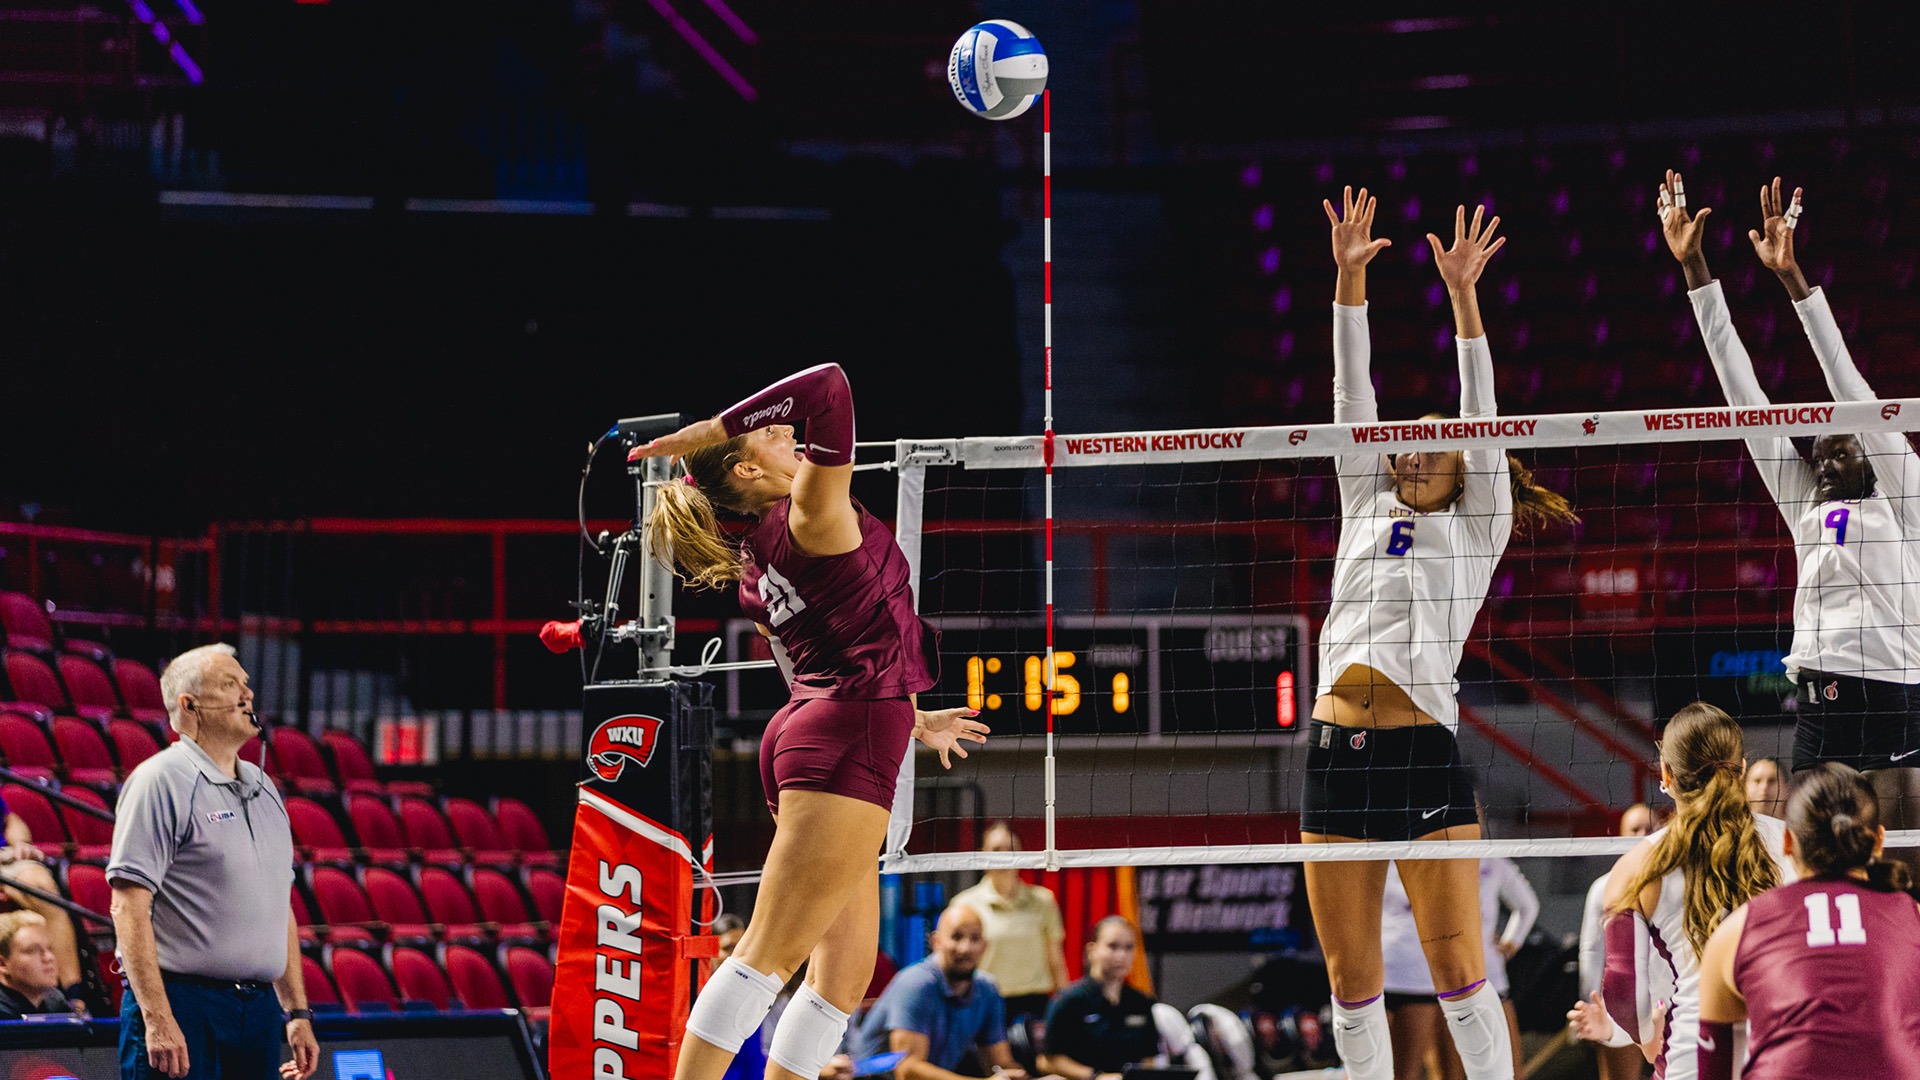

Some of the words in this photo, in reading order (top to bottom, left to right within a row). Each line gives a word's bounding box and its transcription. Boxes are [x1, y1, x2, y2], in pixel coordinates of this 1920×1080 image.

[950, 47, 966, 101] molten
[743, 396, 794, 428] Colonels
[1643, 411, 1731, 431] WESTERN
[1735, 406, 1835, 427] KENTUCKY
[1065, 436, 1147, 455] WESTERN
[1151, 431, 1245, 451] KENTUCKY
[1351, 424, 1437, 443] WESTERN
[1441, 419, 1538, 439] KENTUCKY
[918, 444, 945, 452] Senoh
[1386, 521, 1415, 557] 6
[1825, 508, 1850, 547] 9
[1276, 670, 1295, 727] 1
[606, 726, 645, 747] WKU
[1167, 901, 1291, 932] Network
[1804, 892, 1867, 948] 11
